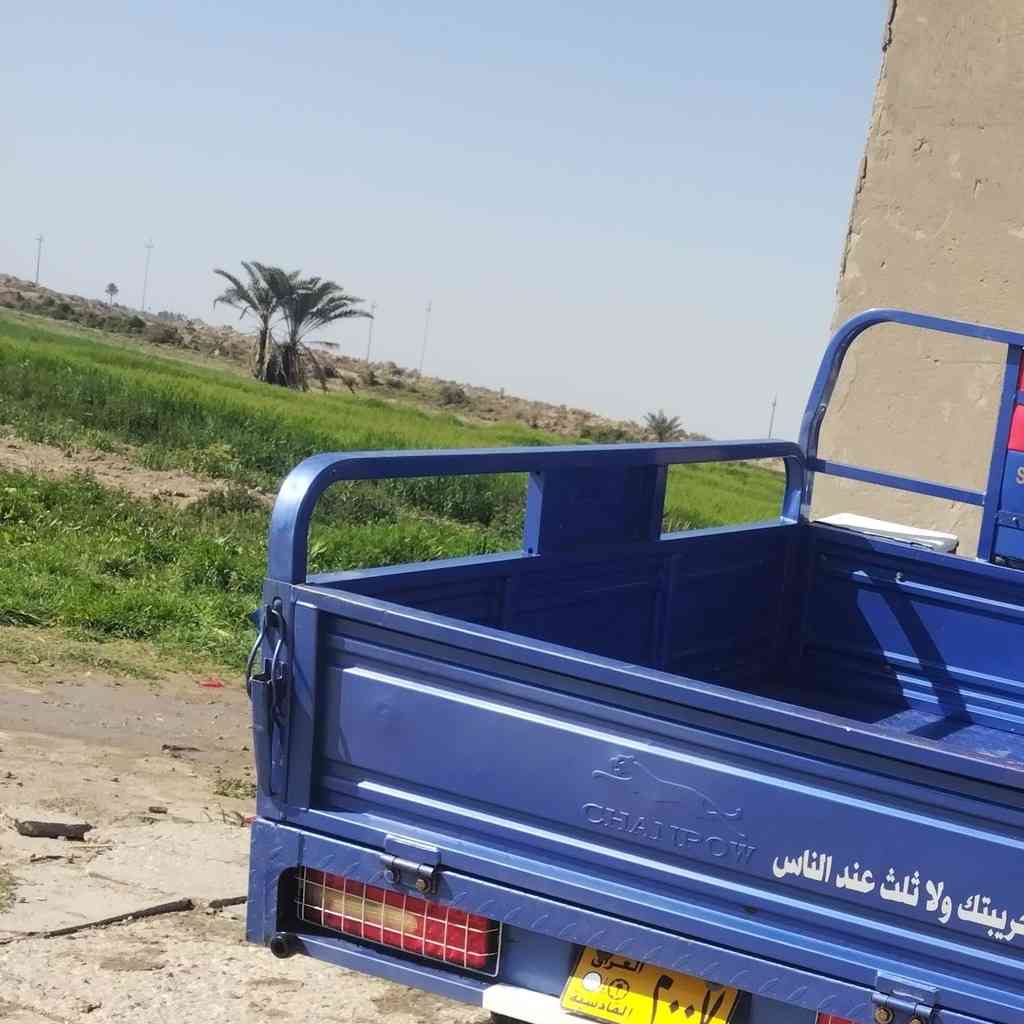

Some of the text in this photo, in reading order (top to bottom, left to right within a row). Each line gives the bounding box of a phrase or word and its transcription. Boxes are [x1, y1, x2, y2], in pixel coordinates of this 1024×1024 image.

[772, 849, 832, 883] الناس
[835, 862, 875, 893] عند
[880, 867, 920, 907] ثلث
[925, 880, 952, 924] ولا
